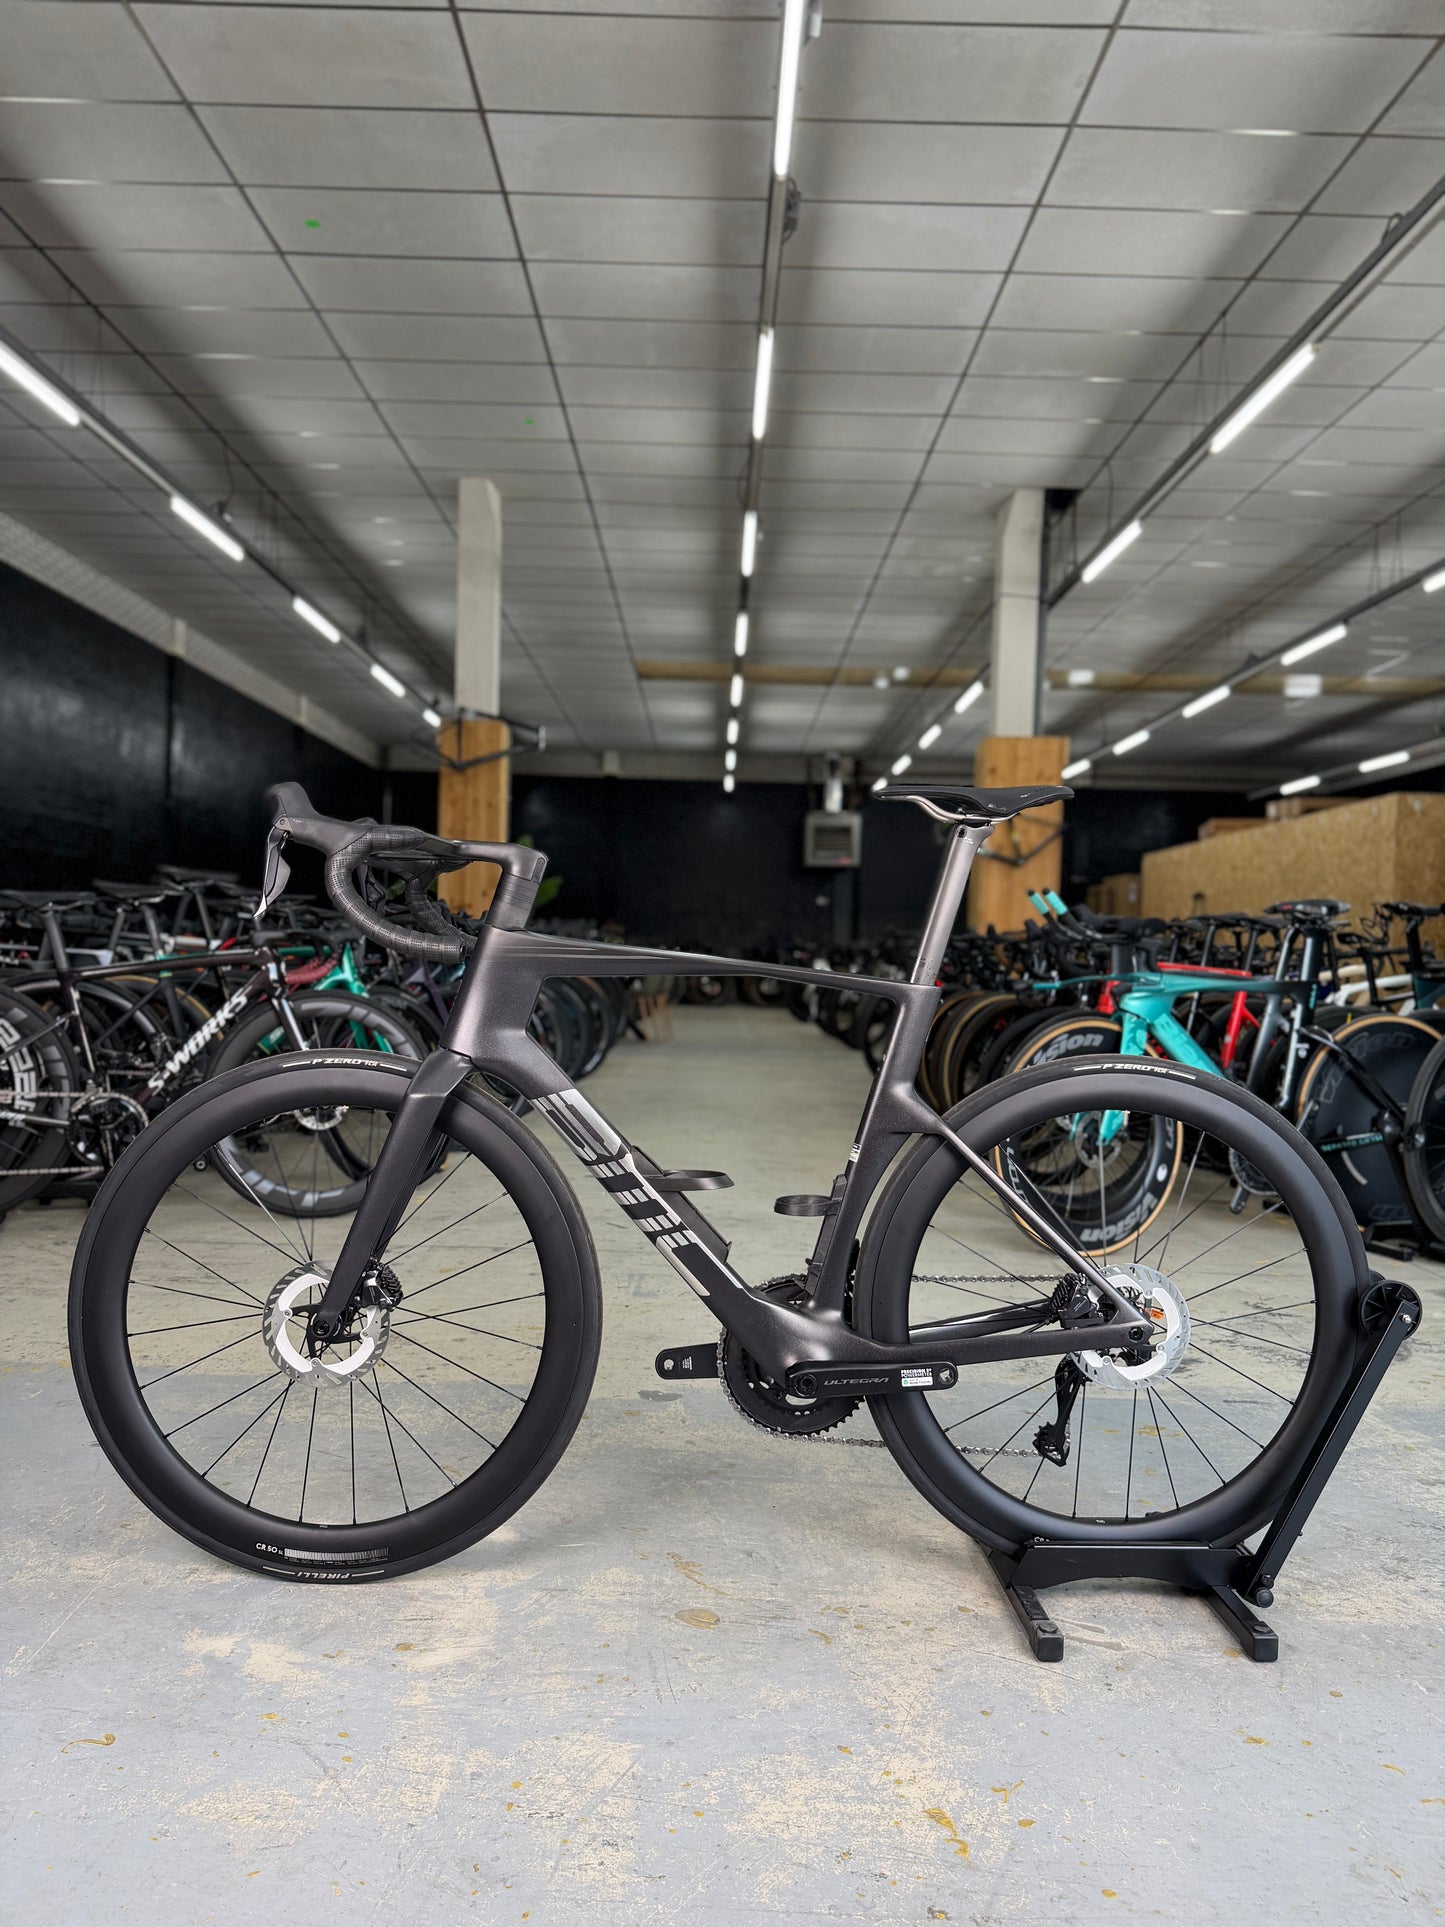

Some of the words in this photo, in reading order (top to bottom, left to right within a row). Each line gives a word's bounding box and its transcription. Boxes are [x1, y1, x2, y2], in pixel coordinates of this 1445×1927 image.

[147, 987, 248, 1097] S-WORKS
[1114, 1063, 1153, 1071] ZERO
[823, 1377, 890, 1385] ULTEGRA
[255, 1542, 267, 1551] CR
[267, 1544, 278, 1553] 50
[295, 1571, 351, 1580] PIRELLI
